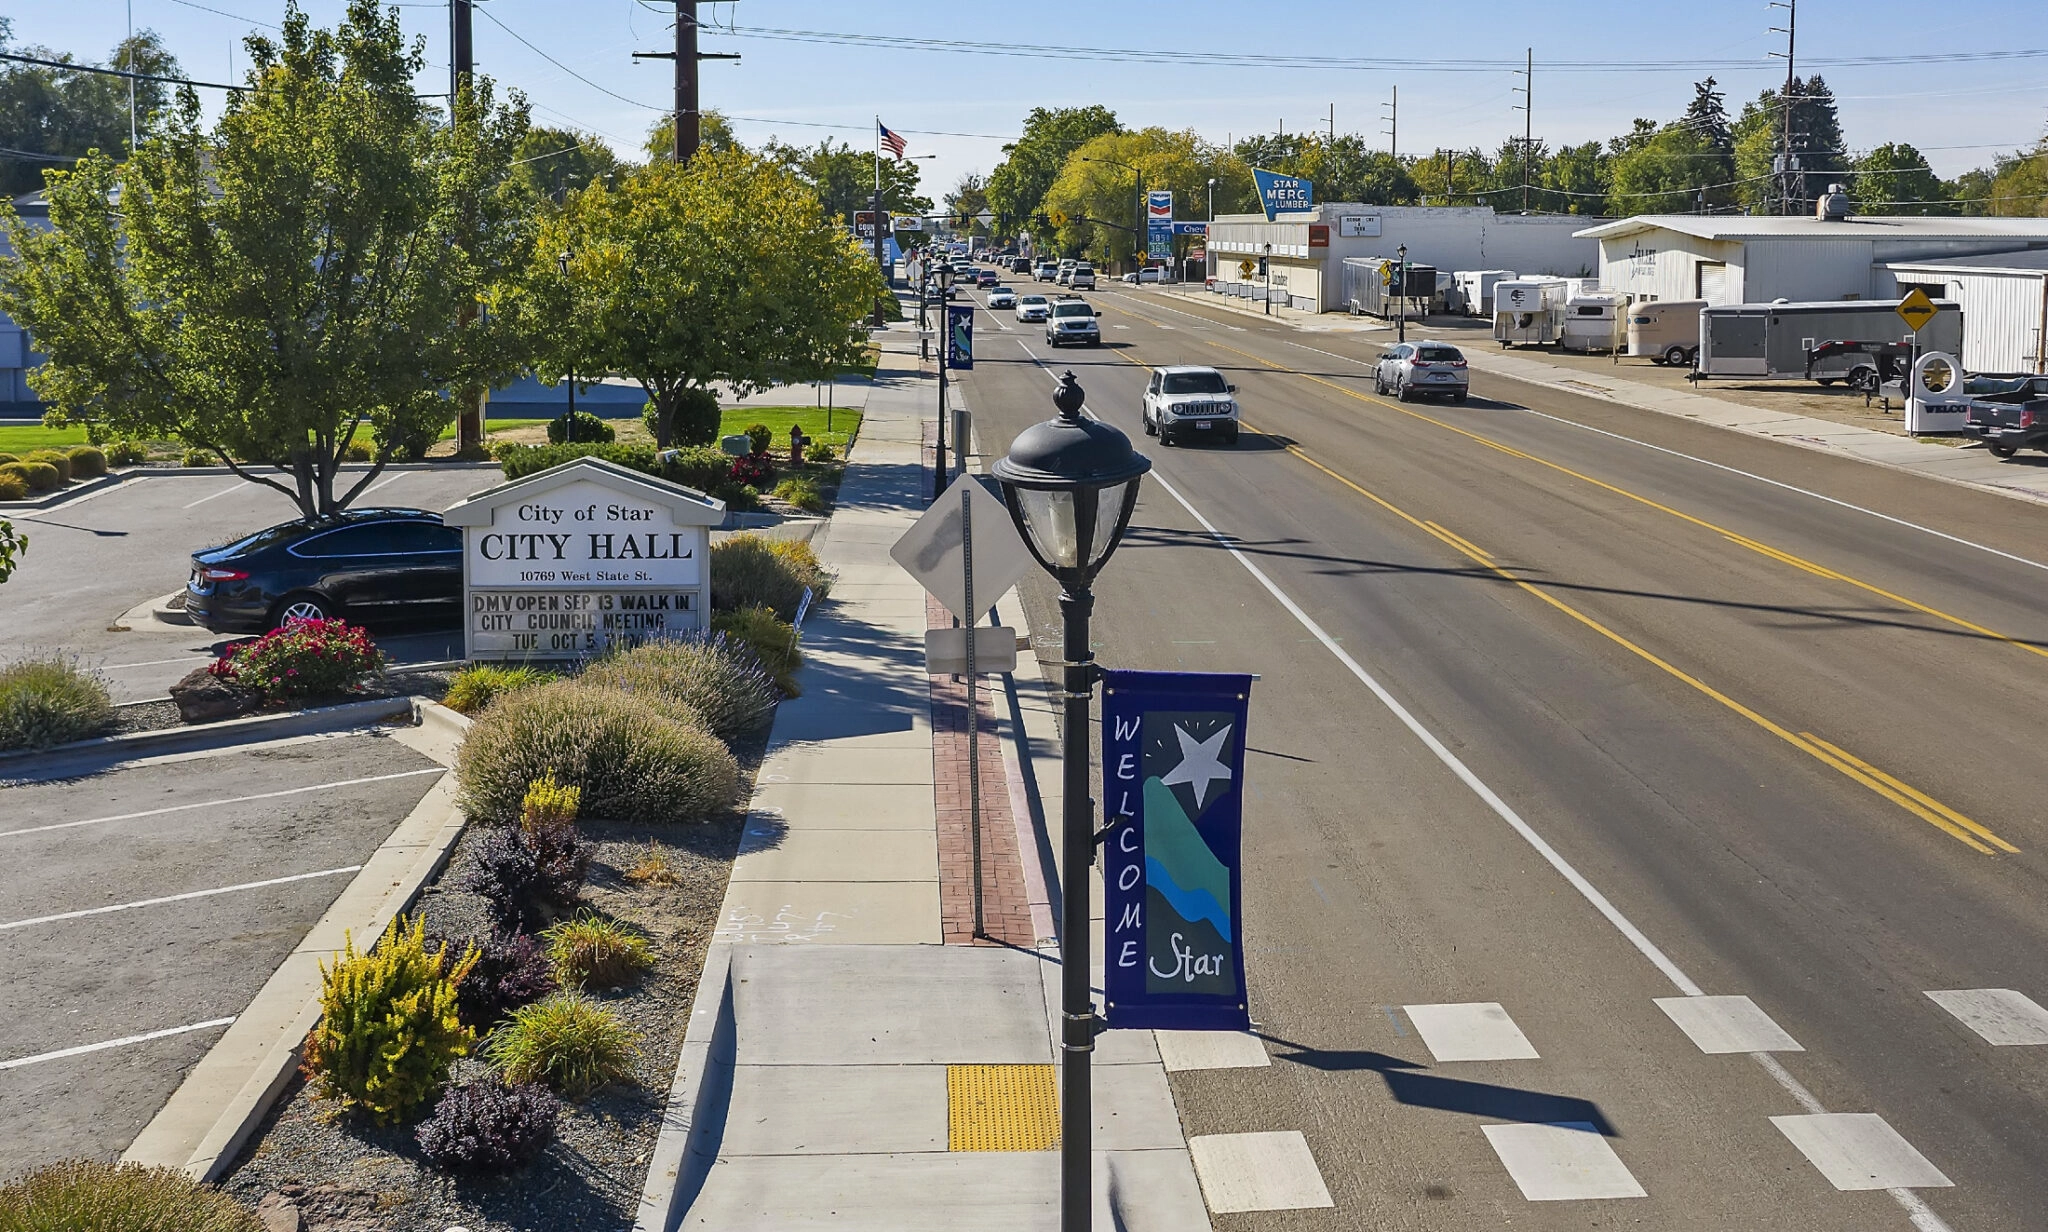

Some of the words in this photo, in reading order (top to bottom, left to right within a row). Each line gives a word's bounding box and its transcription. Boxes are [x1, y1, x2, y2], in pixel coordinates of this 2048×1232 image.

[1273, 180, 1299, 188] STAR
[1266, 189, 1309, 200] MERC.
[1275, 200, 1309, 209] LUMBER
[1924, 404, 1969, 414] WELCO
[518, 504, 564, 525] City
[574, 504, 597, 521] of
[606, 504, 654, 521] Star
[480, 533, 573, 561] CITY
[587, 533, 693, 560] HALL
[520, 570, 556, 582] 10769
[560, 570, 592, 581] West
[596, 570, 630, 581] State
[634, 570, 653, 581] St.
[474, 595, 513, 613] DMV
[515, 595, 560, 611] OPEN
[564, 594, 592, 610] SEP
[597, 594, 614, 611] 13
[620, 594, 671, 611] WALK
[674, 594, 690, 611] IN
[481, 614, 514, 631] CITY
[527, 613, 597, 631] COUNCIL
[603, 612, 665, 631] MEETING
[512, 633, 540, 651] TUE
[551, 633, 579, 650] OCT
[585, 632, 596, 649] 5
[1114, 714, 1142, 968] WELCOME
[1149, 931, 1225, 983] Star
